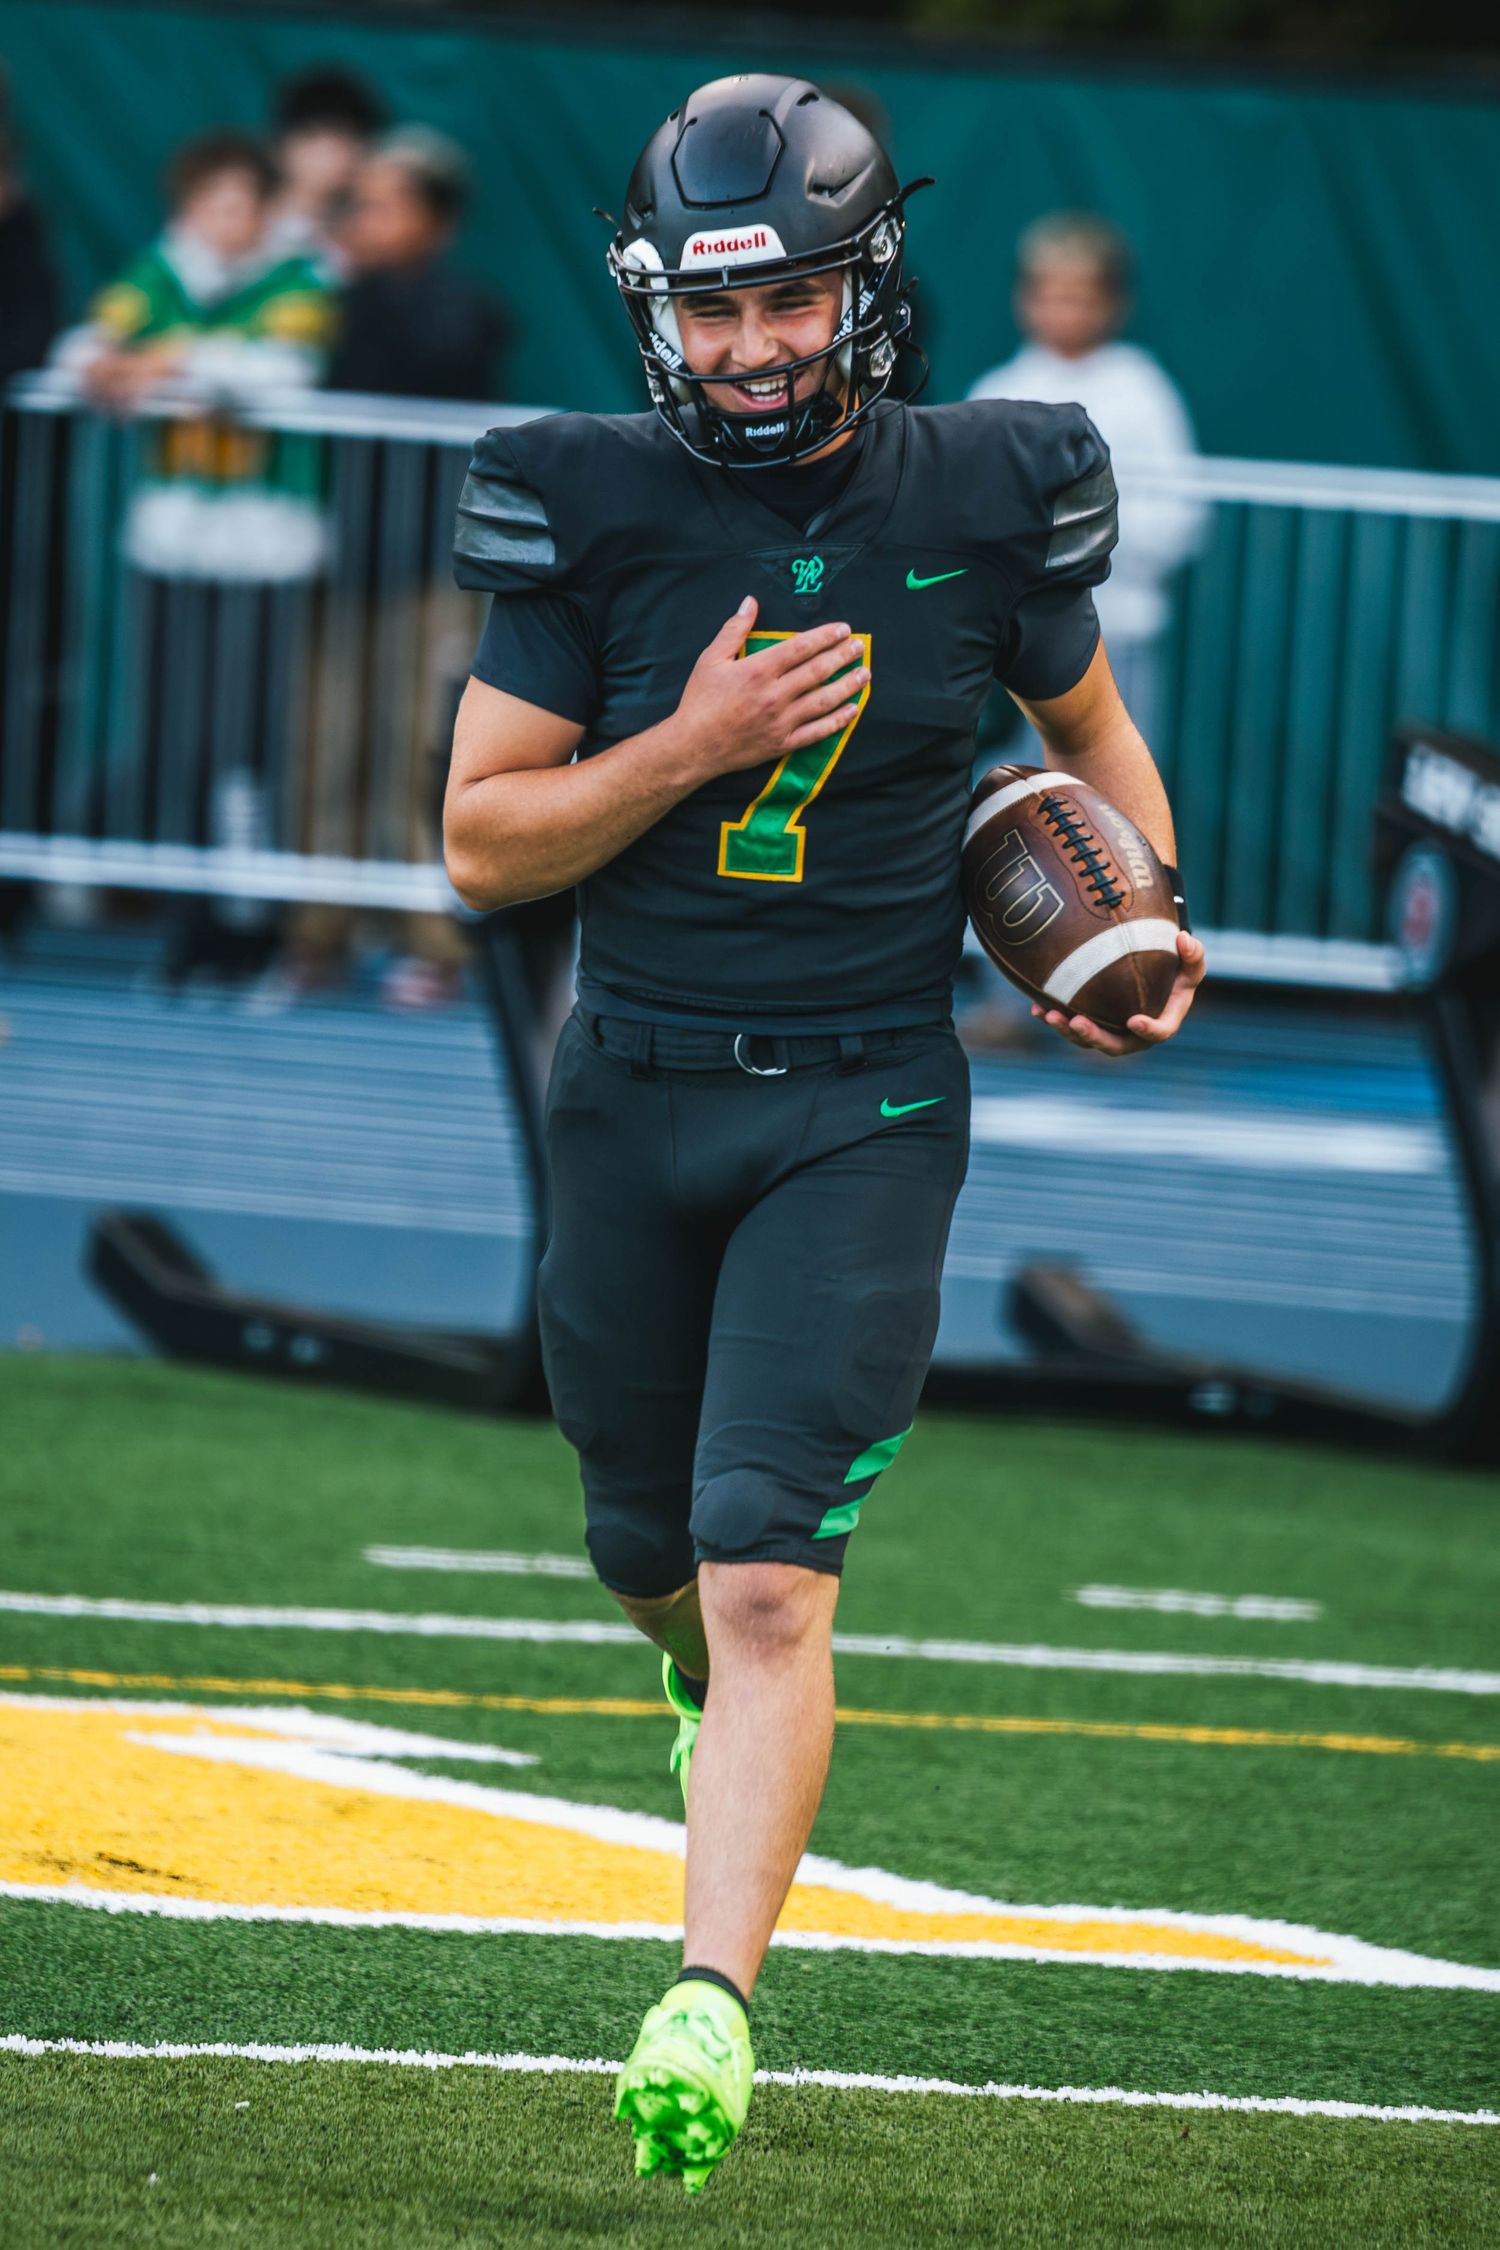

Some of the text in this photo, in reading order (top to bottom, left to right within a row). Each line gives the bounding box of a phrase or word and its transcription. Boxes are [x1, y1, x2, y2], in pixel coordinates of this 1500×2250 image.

[692, 232, 767, 256] Riddell
[745, 422, 785, 437] Riddell
[717, 631, 872, 883] 7
[1097, 803, 1154, 889] Wilson
